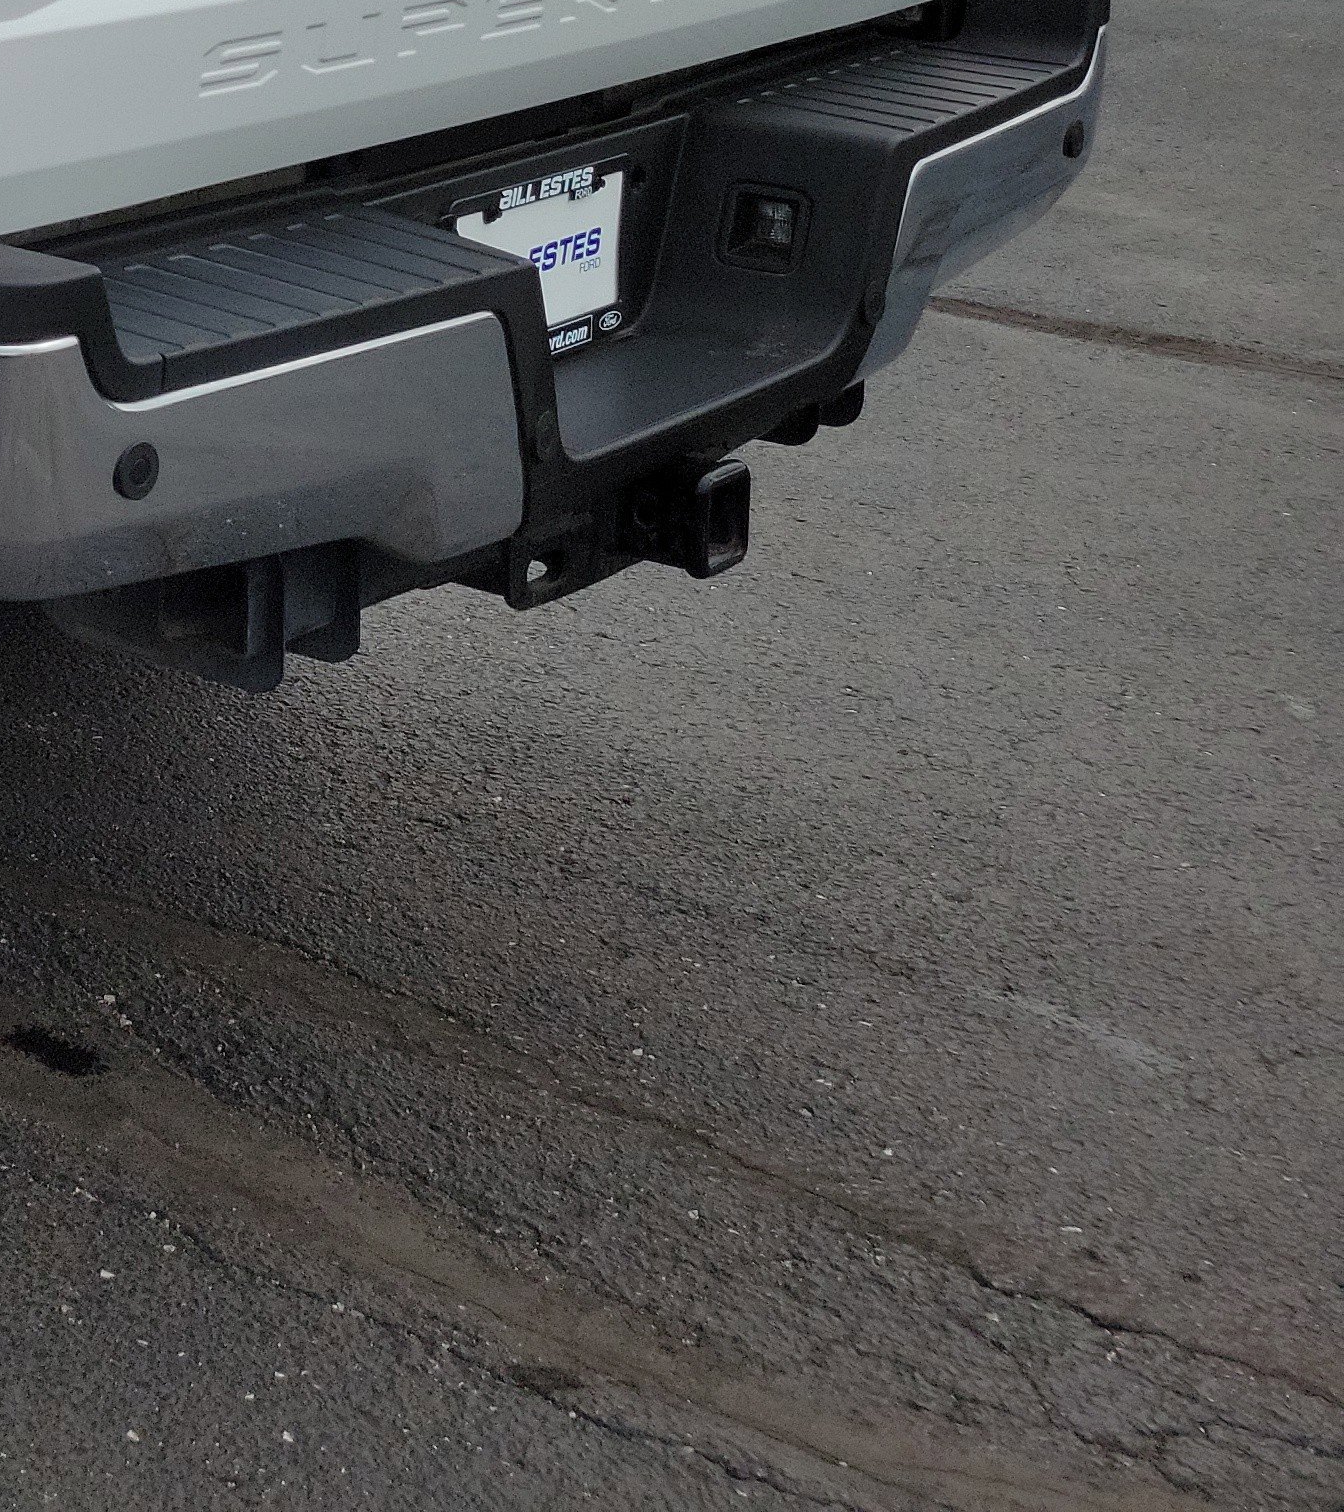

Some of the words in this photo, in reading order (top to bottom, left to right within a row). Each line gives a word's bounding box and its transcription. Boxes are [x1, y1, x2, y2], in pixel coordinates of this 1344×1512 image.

[499, 184, 536, 210] BILL
[539, 166, 594, 198] ESTES
[579, 257, 602, 273] FORD
